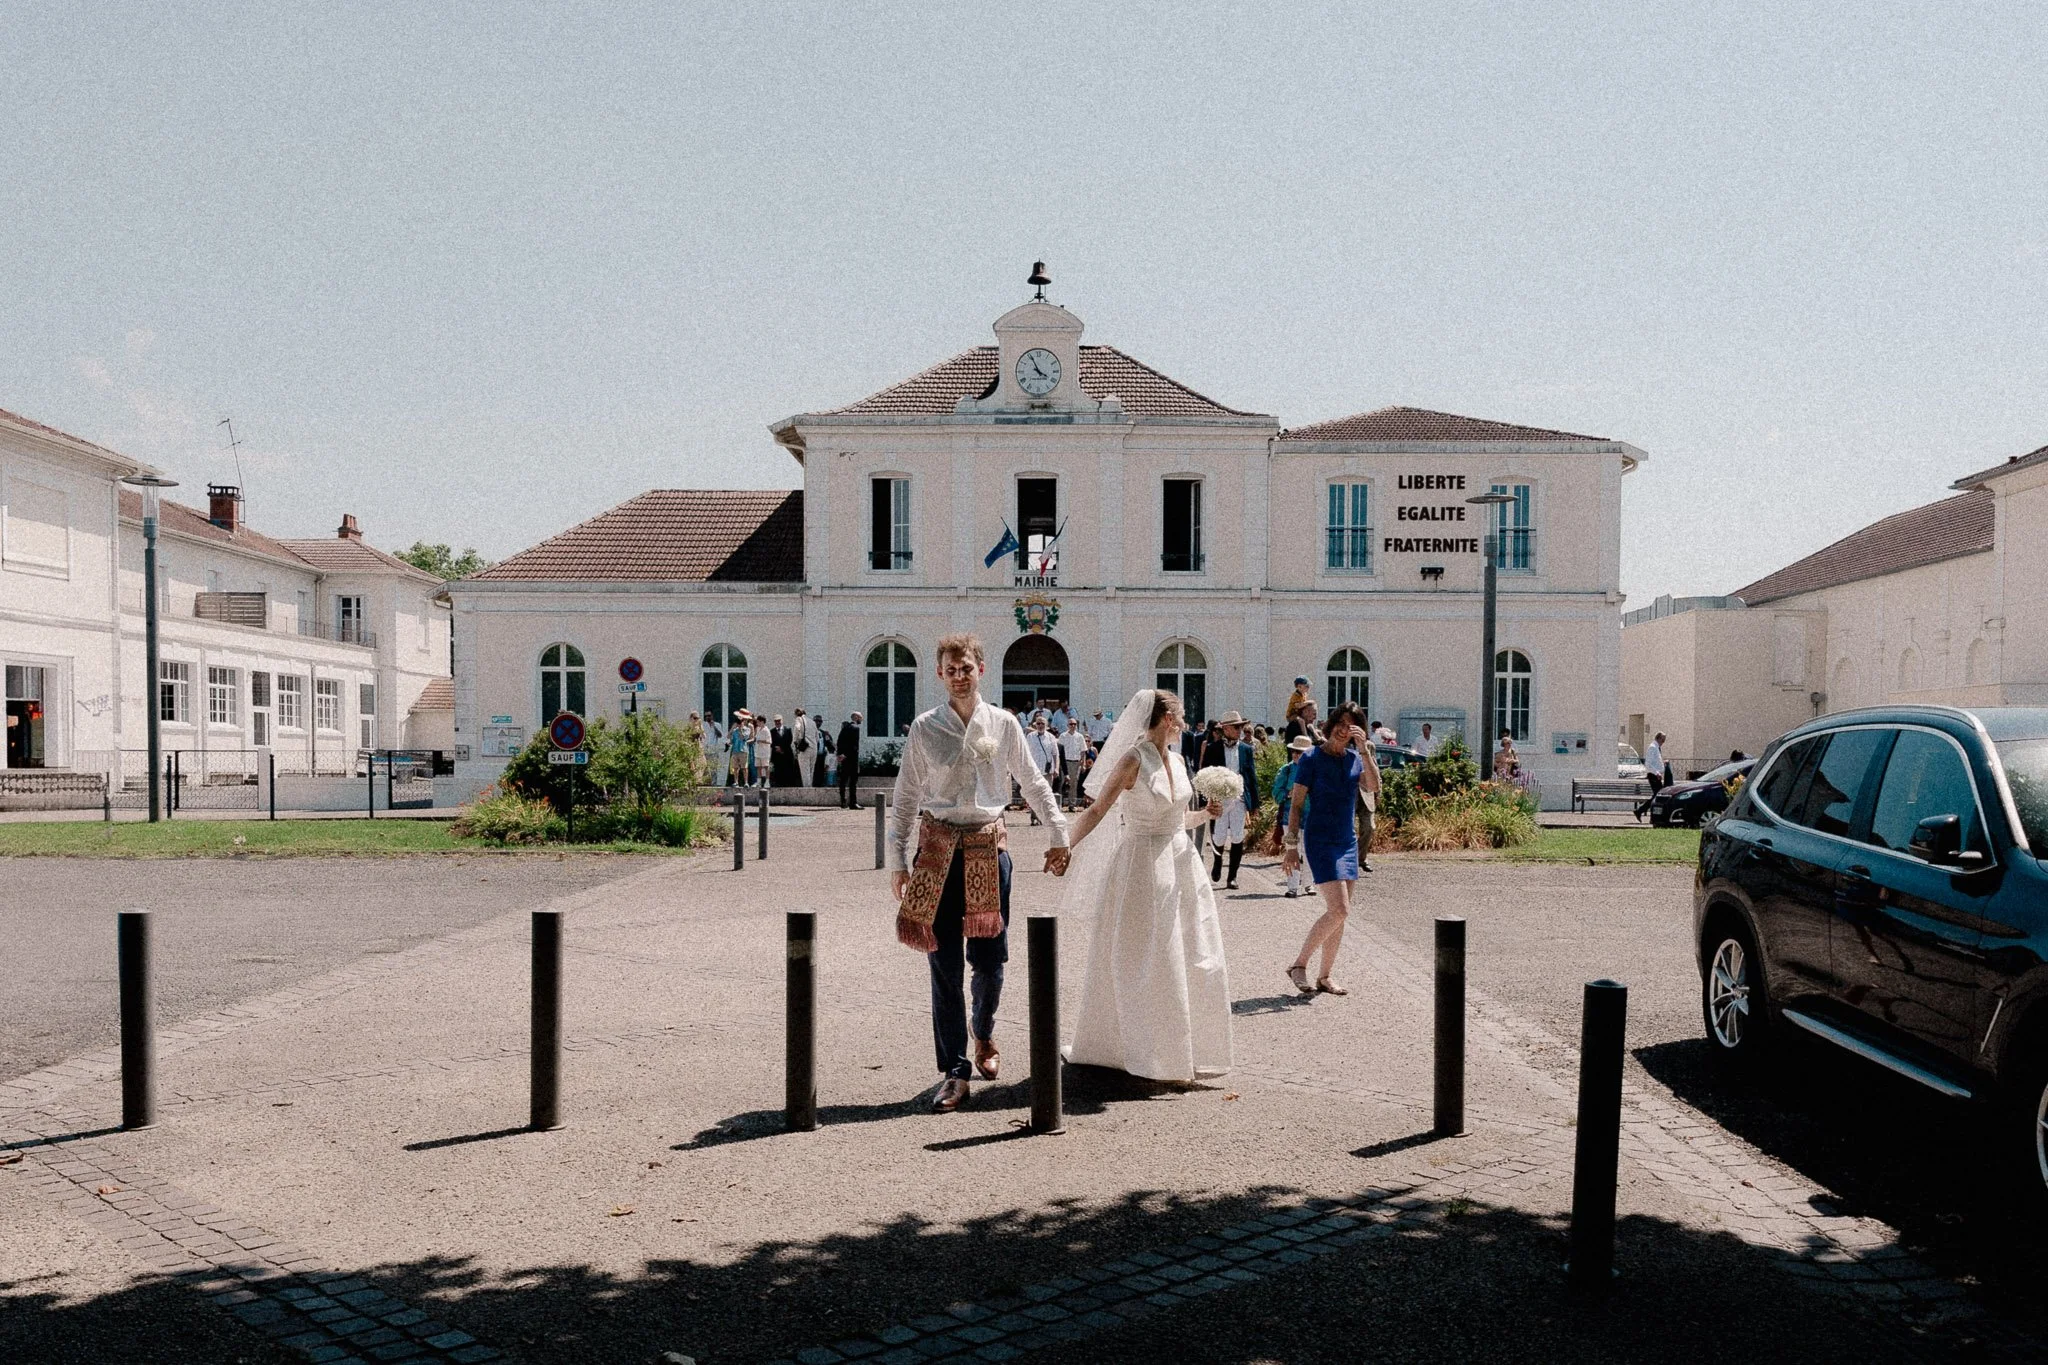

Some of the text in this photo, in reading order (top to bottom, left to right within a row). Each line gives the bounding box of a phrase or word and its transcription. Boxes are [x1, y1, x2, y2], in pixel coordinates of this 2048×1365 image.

[1398, 475, 1466, 489] LIBERTE
[1397, 506, 1466, 521] EGALITE
[1384, 538, 1478, 553] FRATERNITE
[1014, 576, 1058, 587] MAIRIE
[551, 754, 574, 762] SAUF
